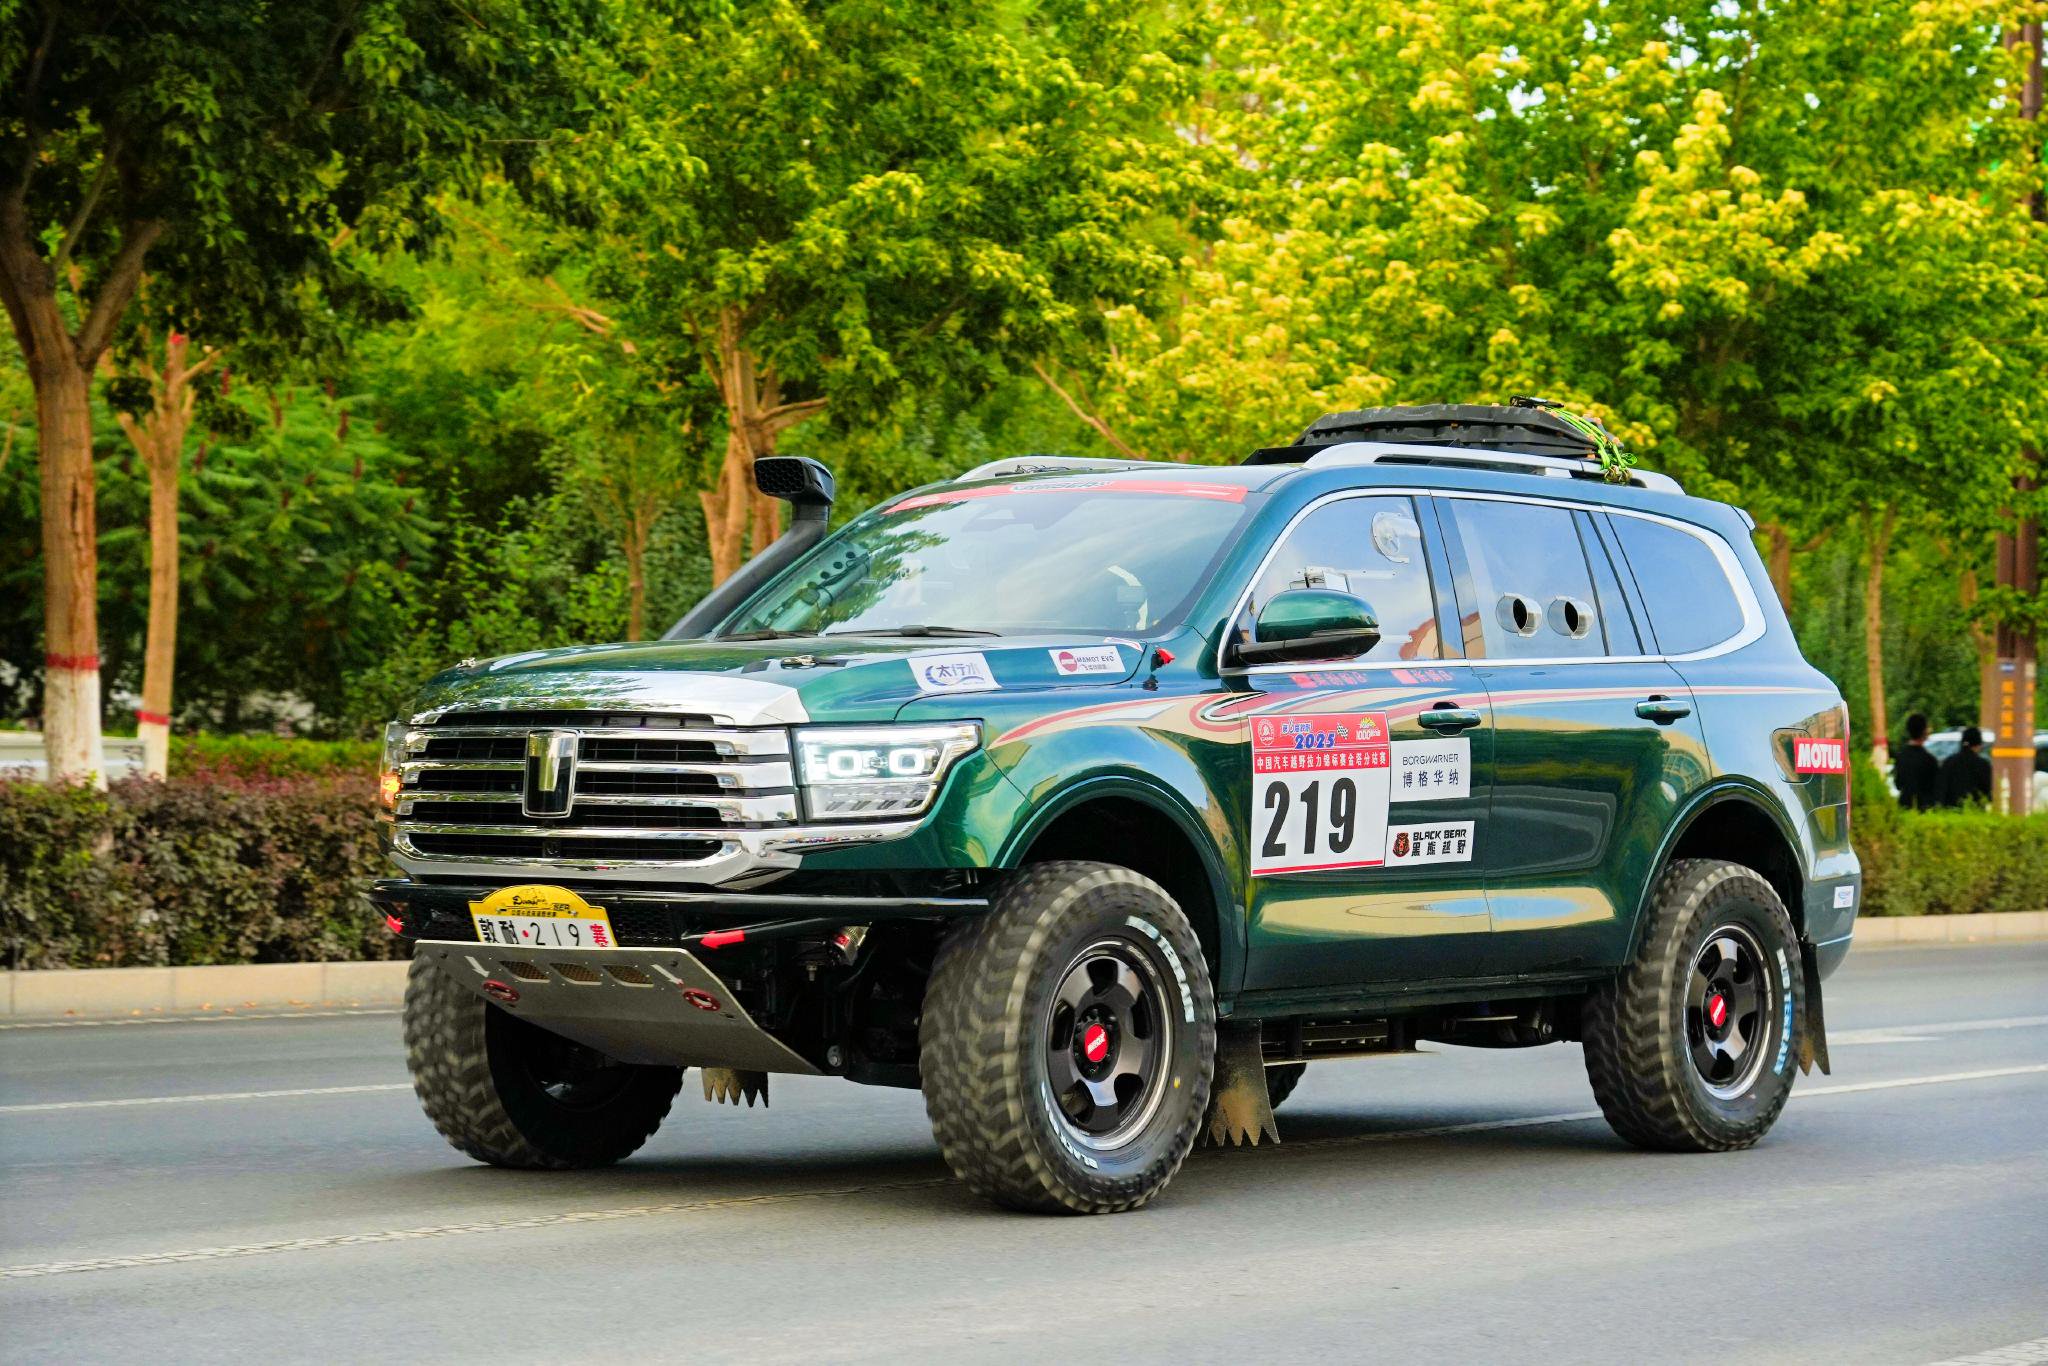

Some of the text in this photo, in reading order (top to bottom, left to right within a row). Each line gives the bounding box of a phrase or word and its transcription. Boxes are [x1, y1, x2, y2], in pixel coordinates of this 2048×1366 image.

[1295, 732, 1336, 749] 2025
[1257, 751, 1387, 770] 中国汽车越野拉力锦标赛金塔分站赛
[1402, 753, 1459, 766] BORGWARNER
[1797, 742, 1843, 769] MOTUL
[1402, 768, 1459, 789] 博格华纳
[1261, 777, 1357, 858] 219
[1412, 828, 1467, 842] BLACK BEAR
[1411, 839, 1467, 857] 黑熊越野
